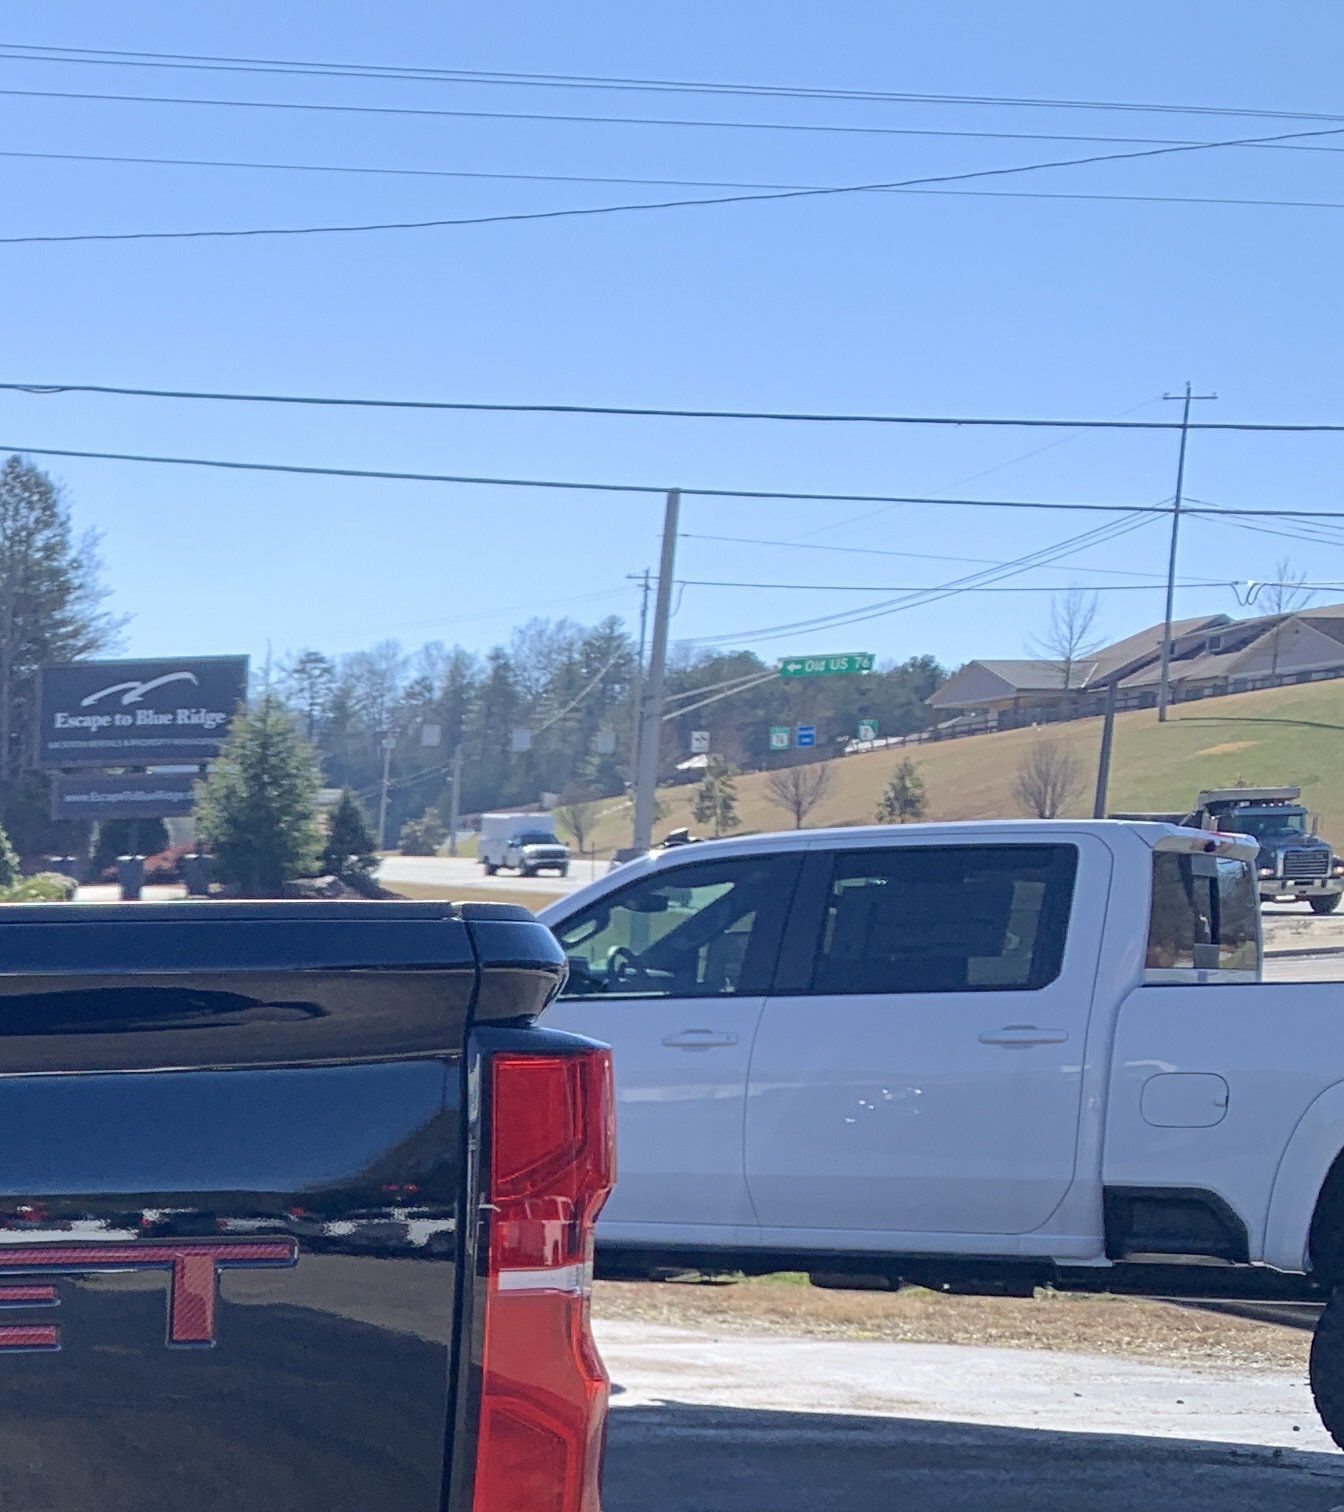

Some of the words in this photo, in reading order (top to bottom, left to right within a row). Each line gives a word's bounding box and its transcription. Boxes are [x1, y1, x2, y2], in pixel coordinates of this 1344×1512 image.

[805, 659, 827, 672] Old
[830, 658, 849, 670] US
[855, 656, 870, 669] 76
[54, 712, 112, 732] Escape
[114, 713, 133, 726] to
[136, 708, 174, 725] Blue
[176, 707, 227, 729] Ridge
